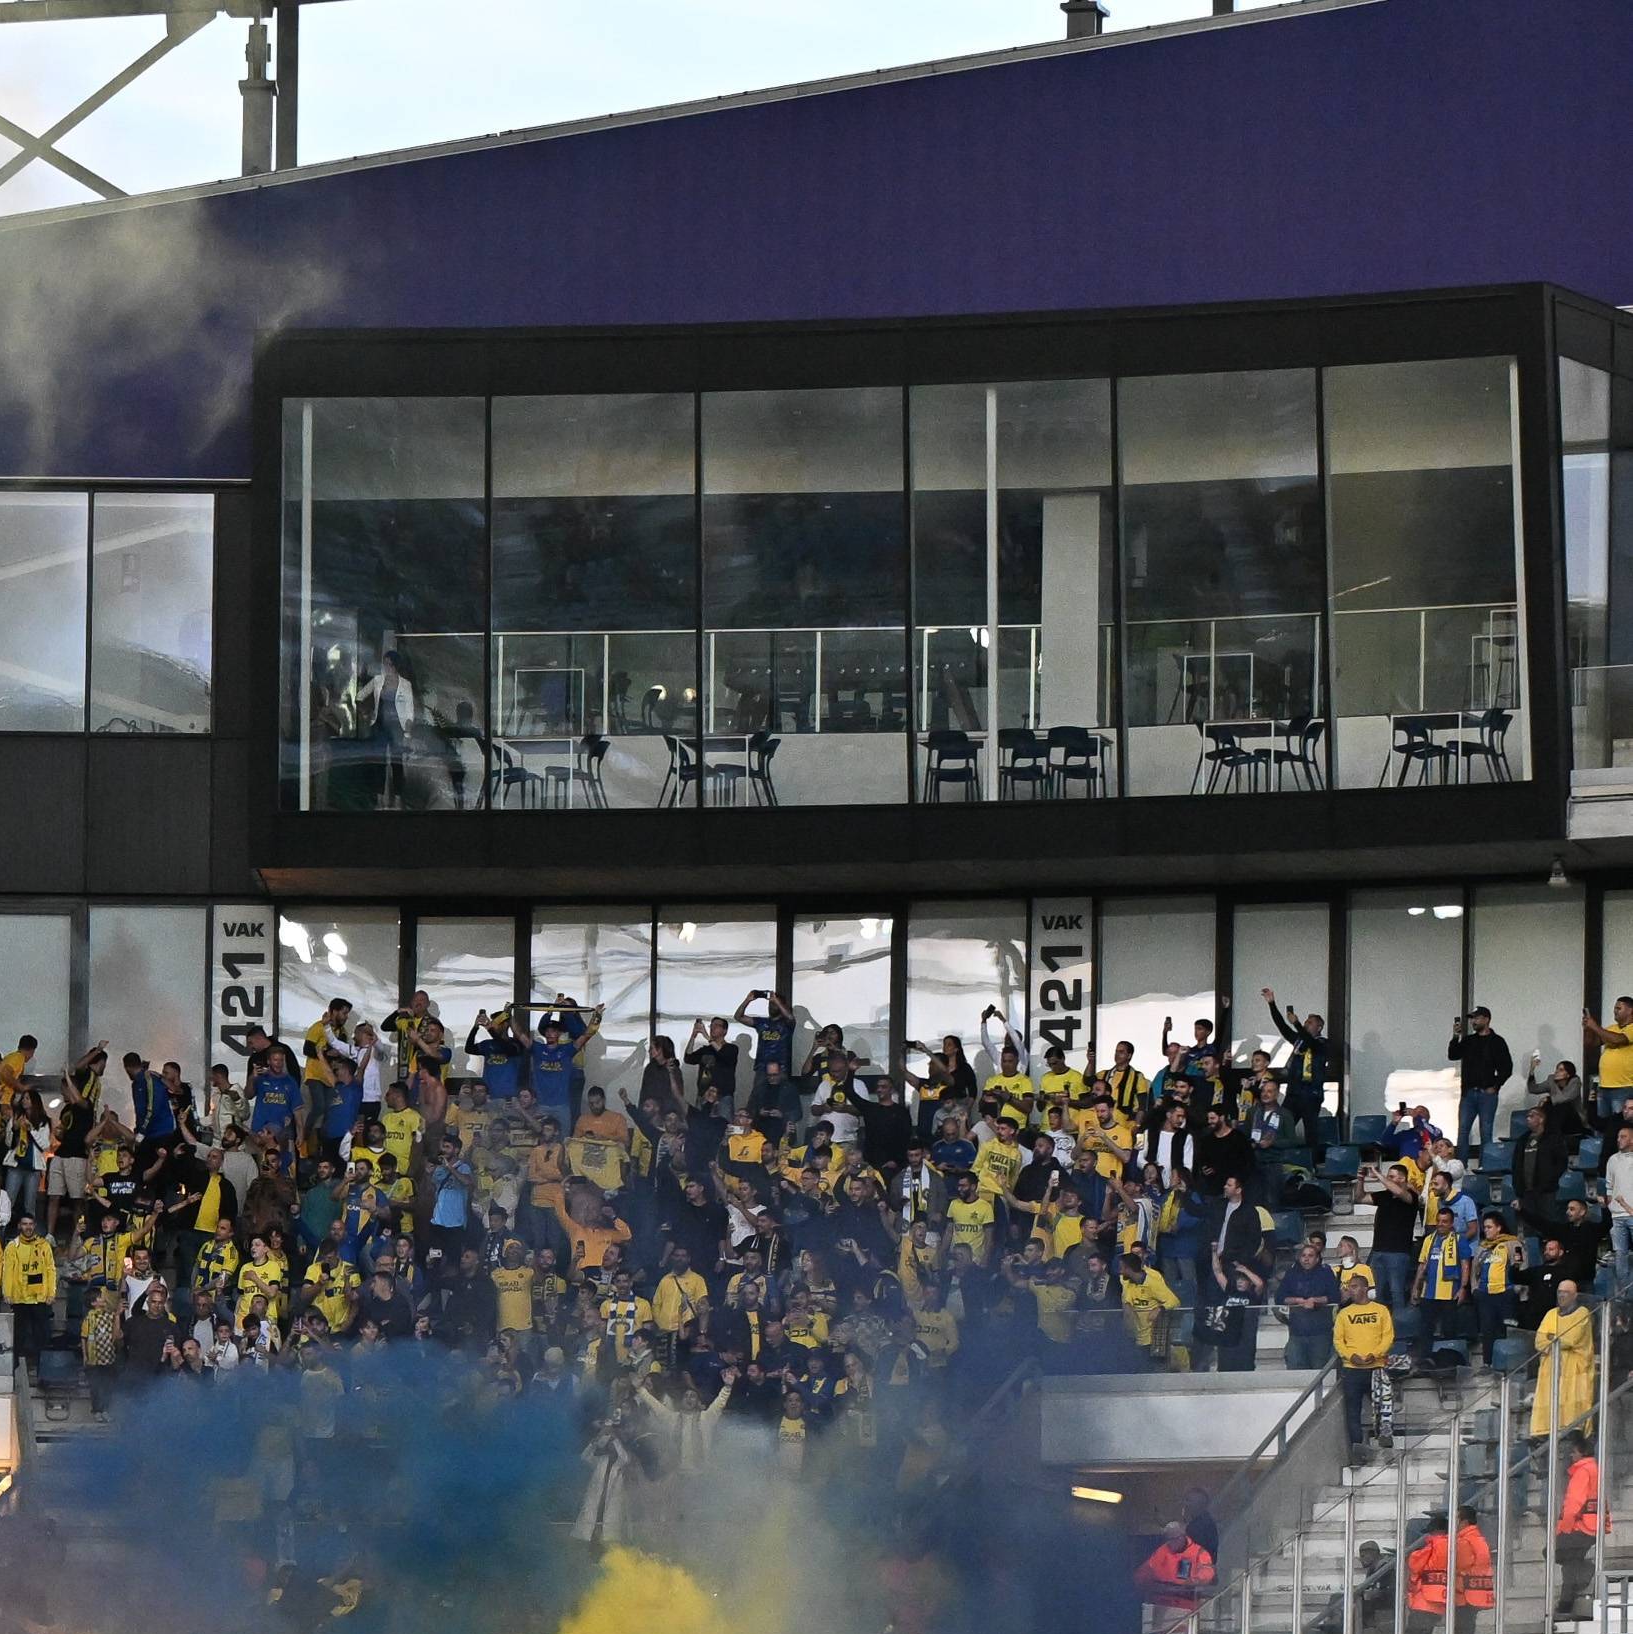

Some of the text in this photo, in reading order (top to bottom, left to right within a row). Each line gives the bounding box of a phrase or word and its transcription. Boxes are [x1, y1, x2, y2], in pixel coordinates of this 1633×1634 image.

[222, 922, 265, 938] VAK
[1041, 915, 1083, 930] VAK
[220, 952, 265, 1056] 421
[1039, 945, 1083, 1052] 421
[1348, 1313, 1378, 1325] VANS
